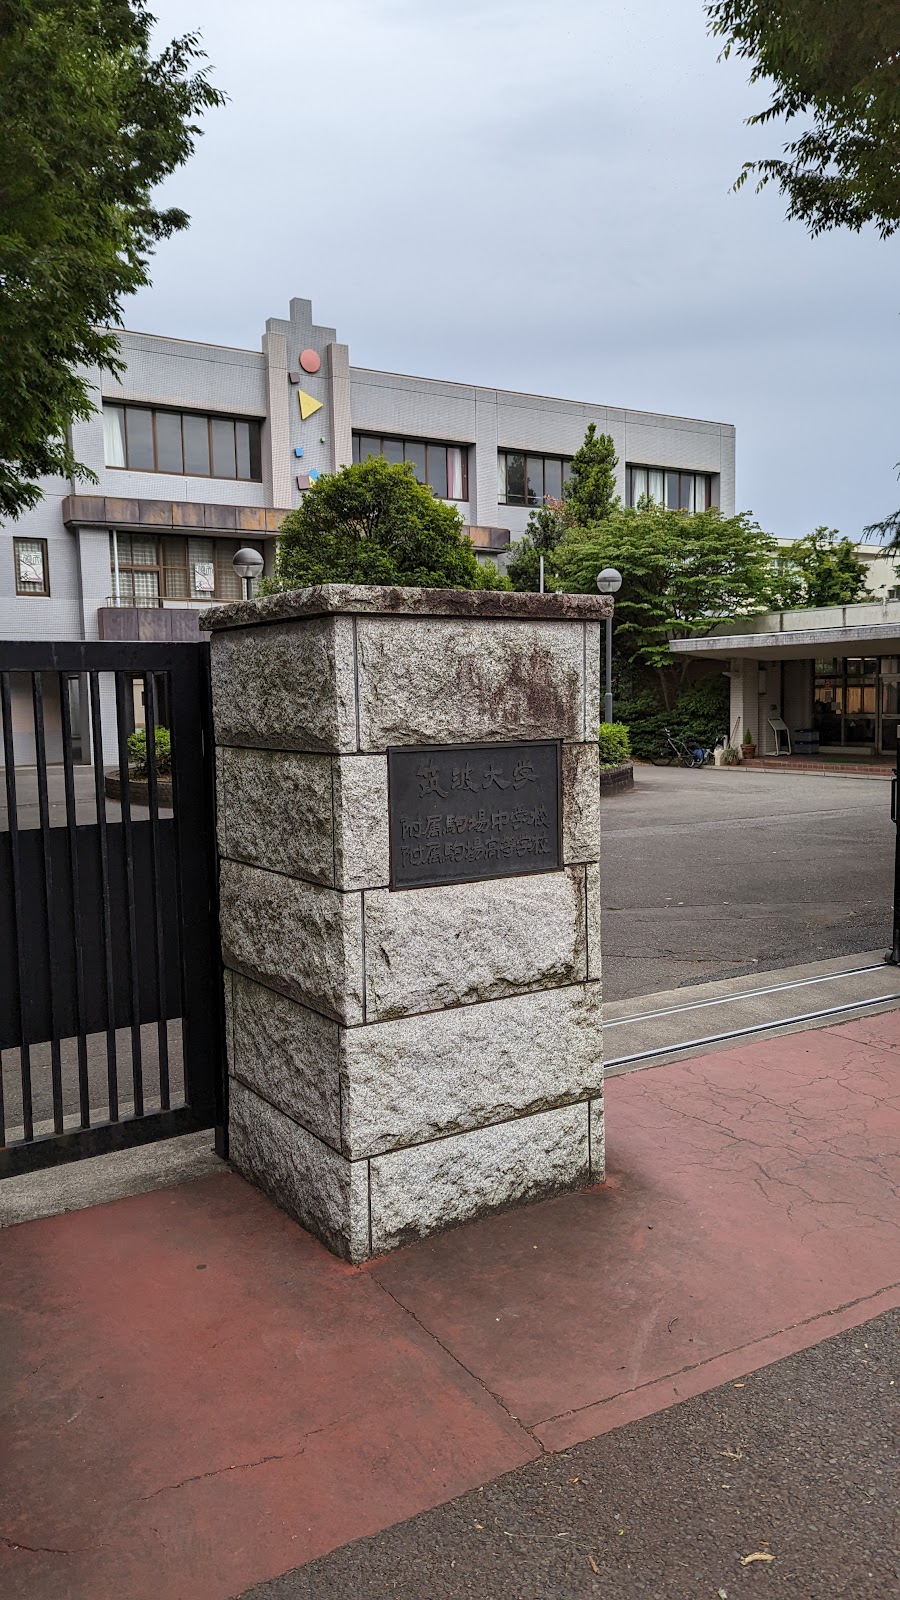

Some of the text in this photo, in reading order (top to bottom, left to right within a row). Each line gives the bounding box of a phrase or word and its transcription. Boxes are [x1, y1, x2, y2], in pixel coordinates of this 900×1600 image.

[416, 759, 540, 799] 筑波大学
[400, 805, 550, 841] 附属駒場中学校
[400, 831, 551, 868] 附属駒場高等学校
